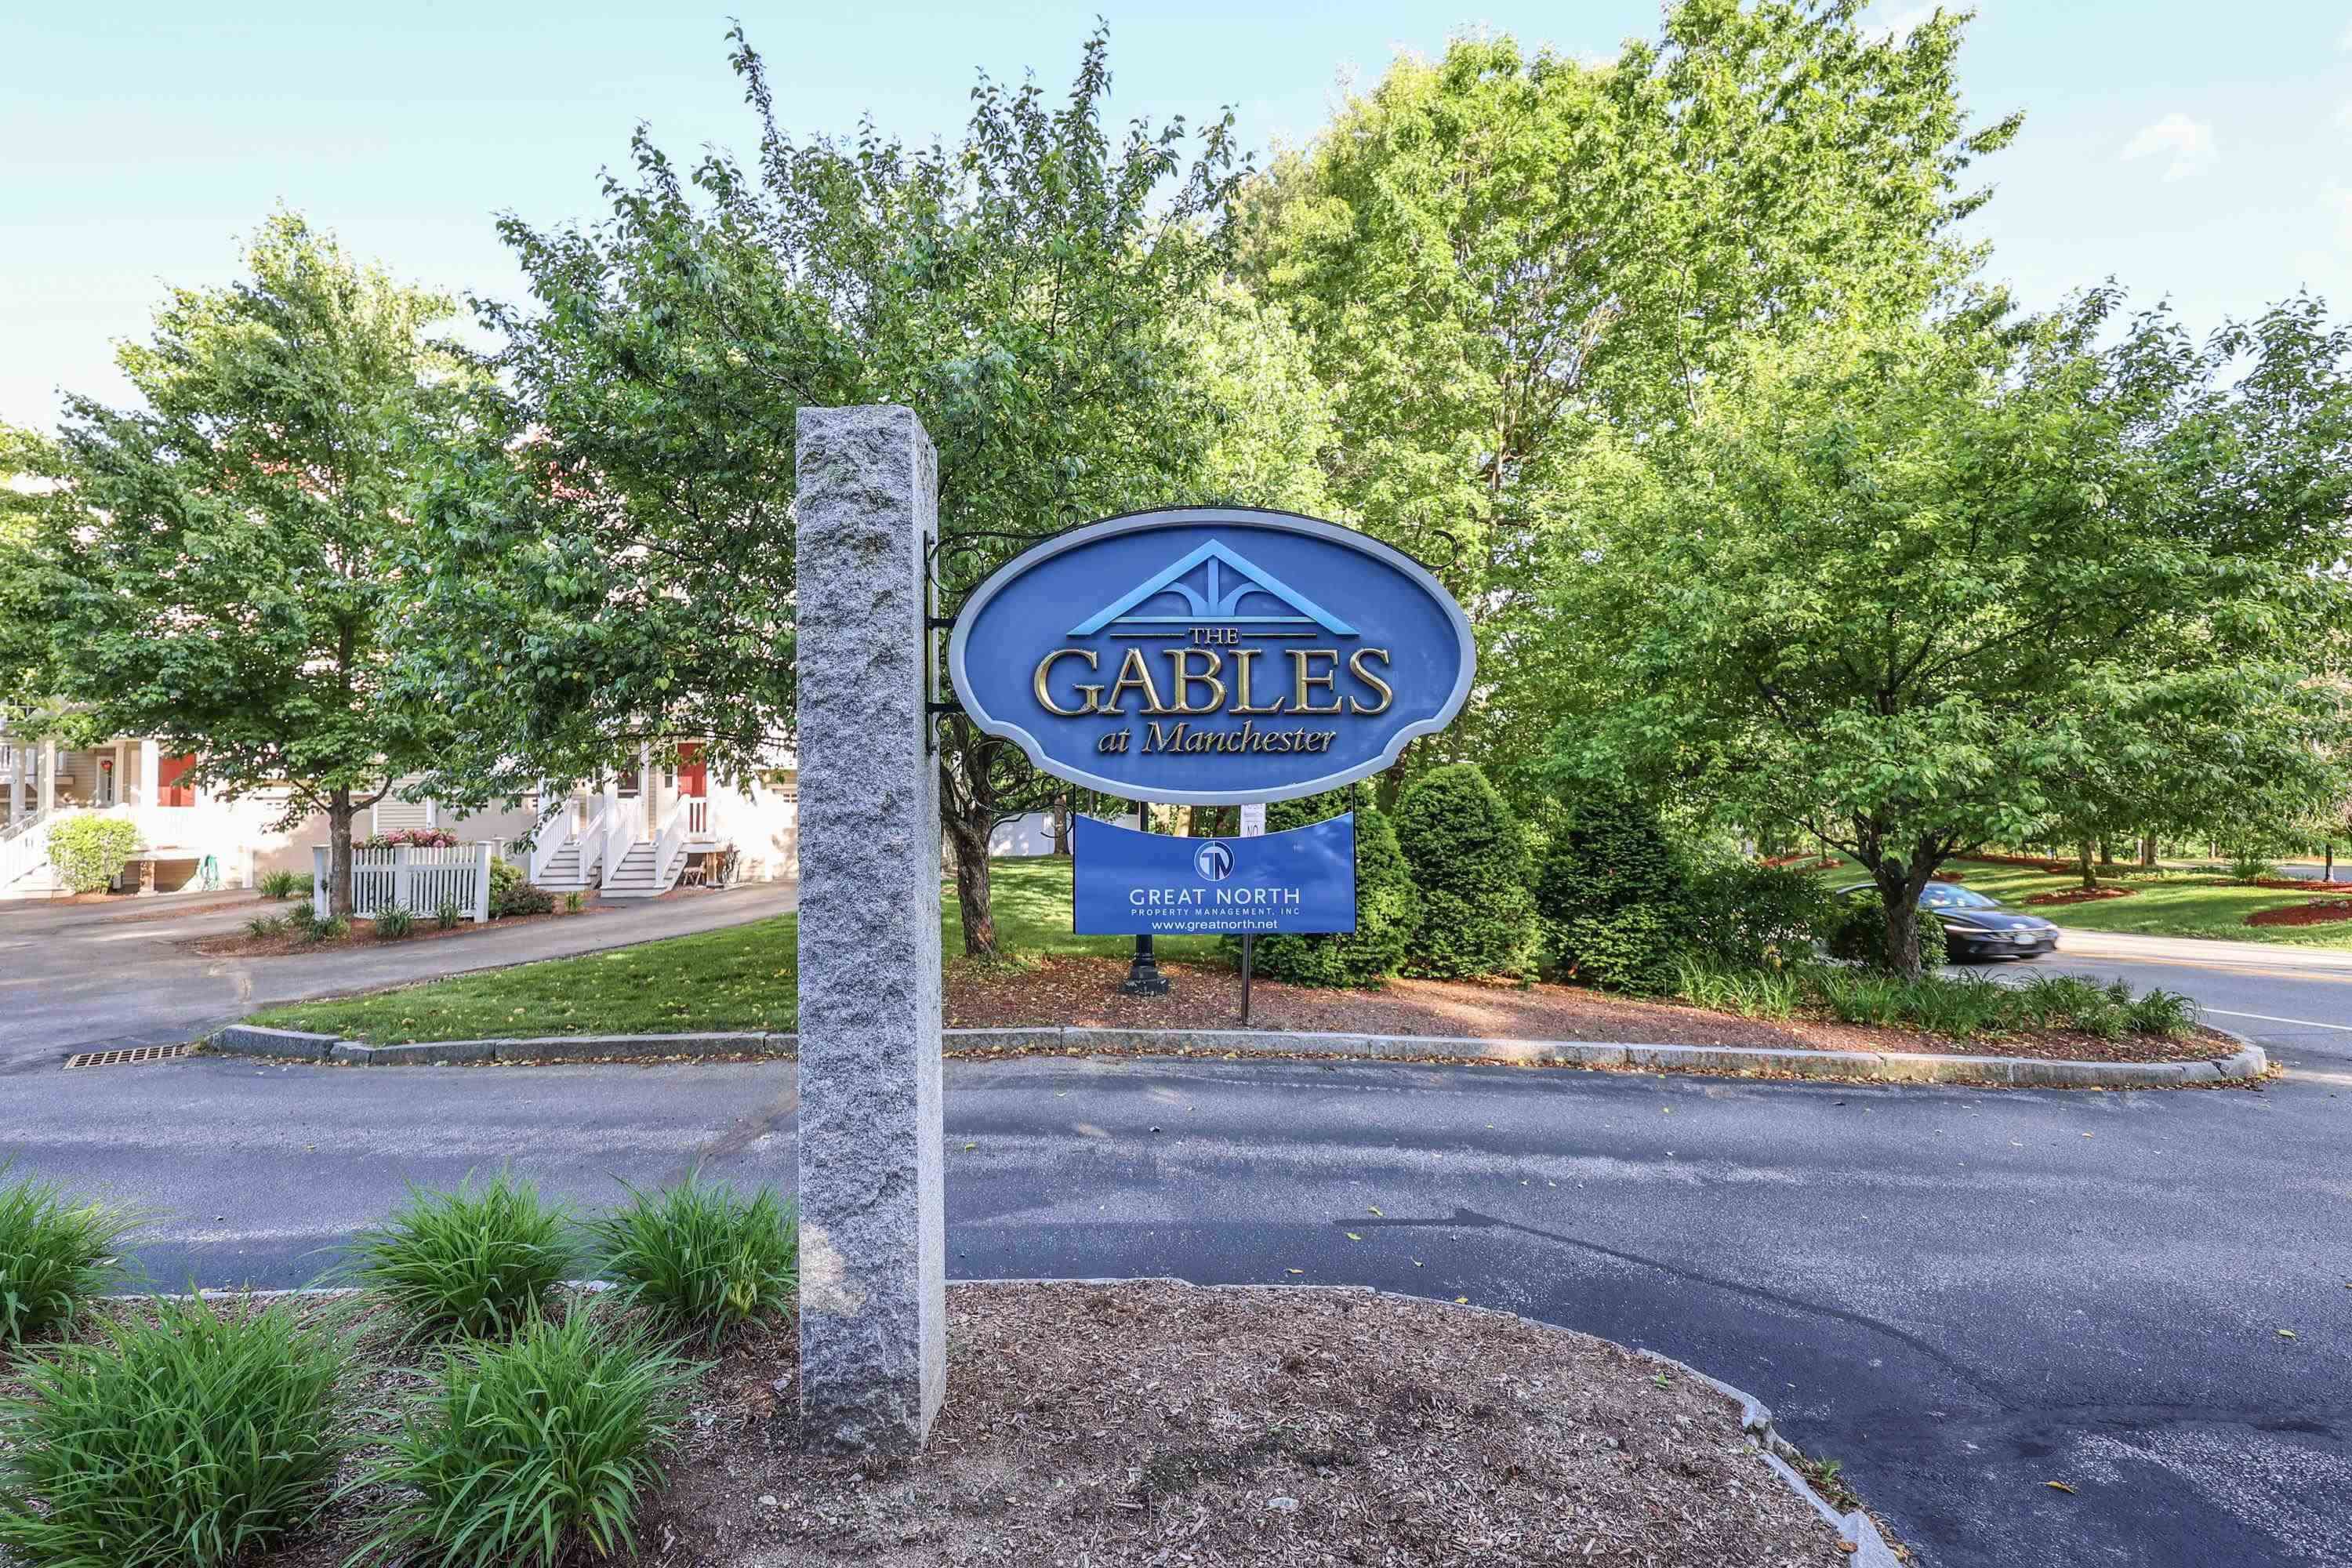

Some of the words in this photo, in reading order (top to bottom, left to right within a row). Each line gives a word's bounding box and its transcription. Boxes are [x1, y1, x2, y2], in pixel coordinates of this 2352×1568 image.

[1189, 627, 1240, 644] THE
[1033, 648, 1393, 715] GABLES
[1098, 728, 1131, 753] at
[1141, 720, 1337, 753] Manchester
[1129, 889, 1207, 906] GREAT
[1216, 888, 1300, 905] NORTH
[1152, 920, 1278, 931] www.greatnorth.net
